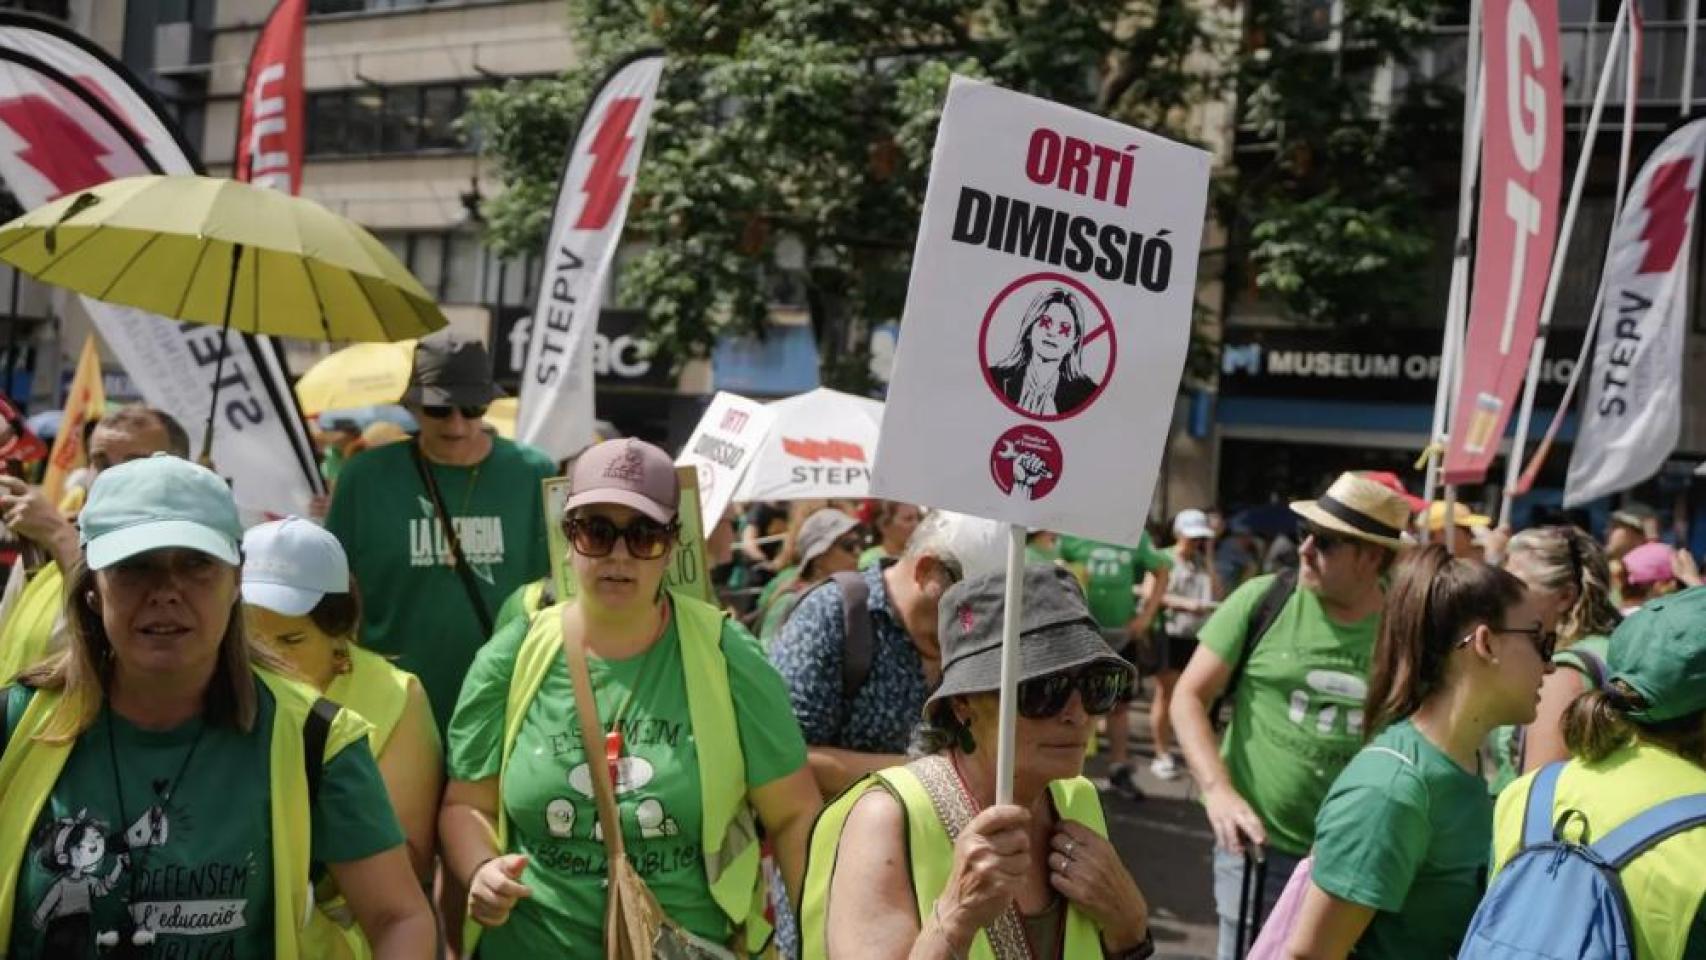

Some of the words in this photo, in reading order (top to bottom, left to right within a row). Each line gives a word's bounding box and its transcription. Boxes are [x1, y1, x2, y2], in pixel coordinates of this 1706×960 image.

[1025, 127, 1140, 208] ORTÍ
[951, 185, 1174, 293] DIMISSIÓ
[536, 246, 585, 385] STEPV
[1598, 290, 1653, 417] STEPV
[1267, 350, 1399, 379] MUSEUM
[144, 862, 248, 899] DEFENSEM
